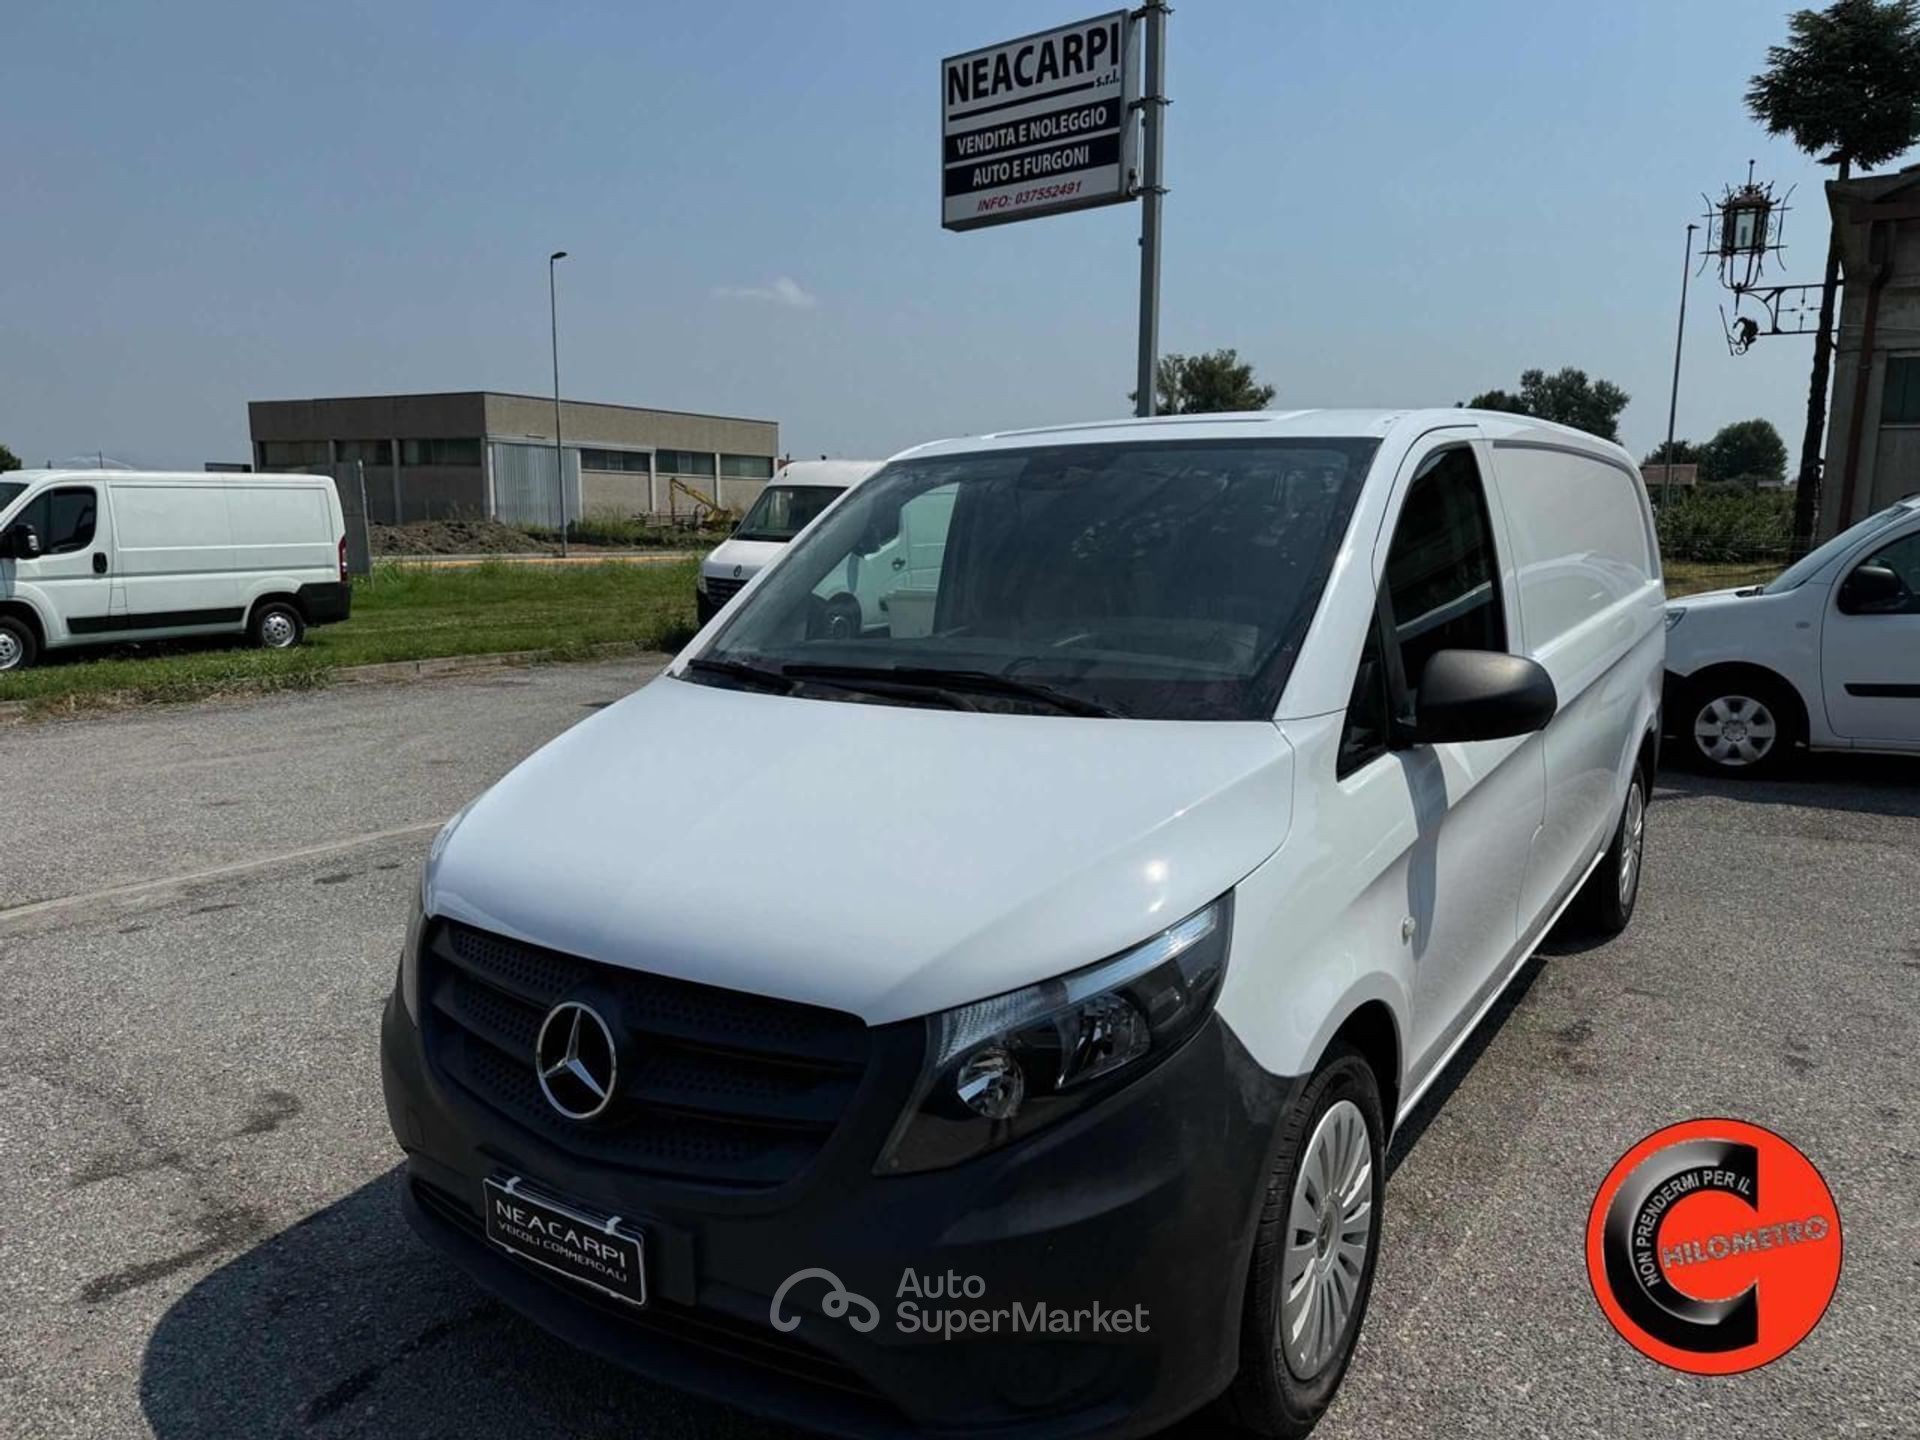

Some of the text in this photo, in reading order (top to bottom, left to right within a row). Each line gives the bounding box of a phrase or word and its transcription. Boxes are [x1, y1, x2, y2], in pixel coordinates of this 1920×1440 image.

[948, 22, 1119, 106] NEACARPI
[1096, 70, 1119, 87] s.r.l.
[957, 106, 1107, 156] VENDITA E NOLEGGIO
[972, 145, 1089, 187] AUTO E FURGONI
[977, 181, 1082, 212] INFO: 037552491
[496, 1199, 626, 1268] NEACARPI
[498, 1219, 628, 1283] VEICOLI COMMERCIALI
